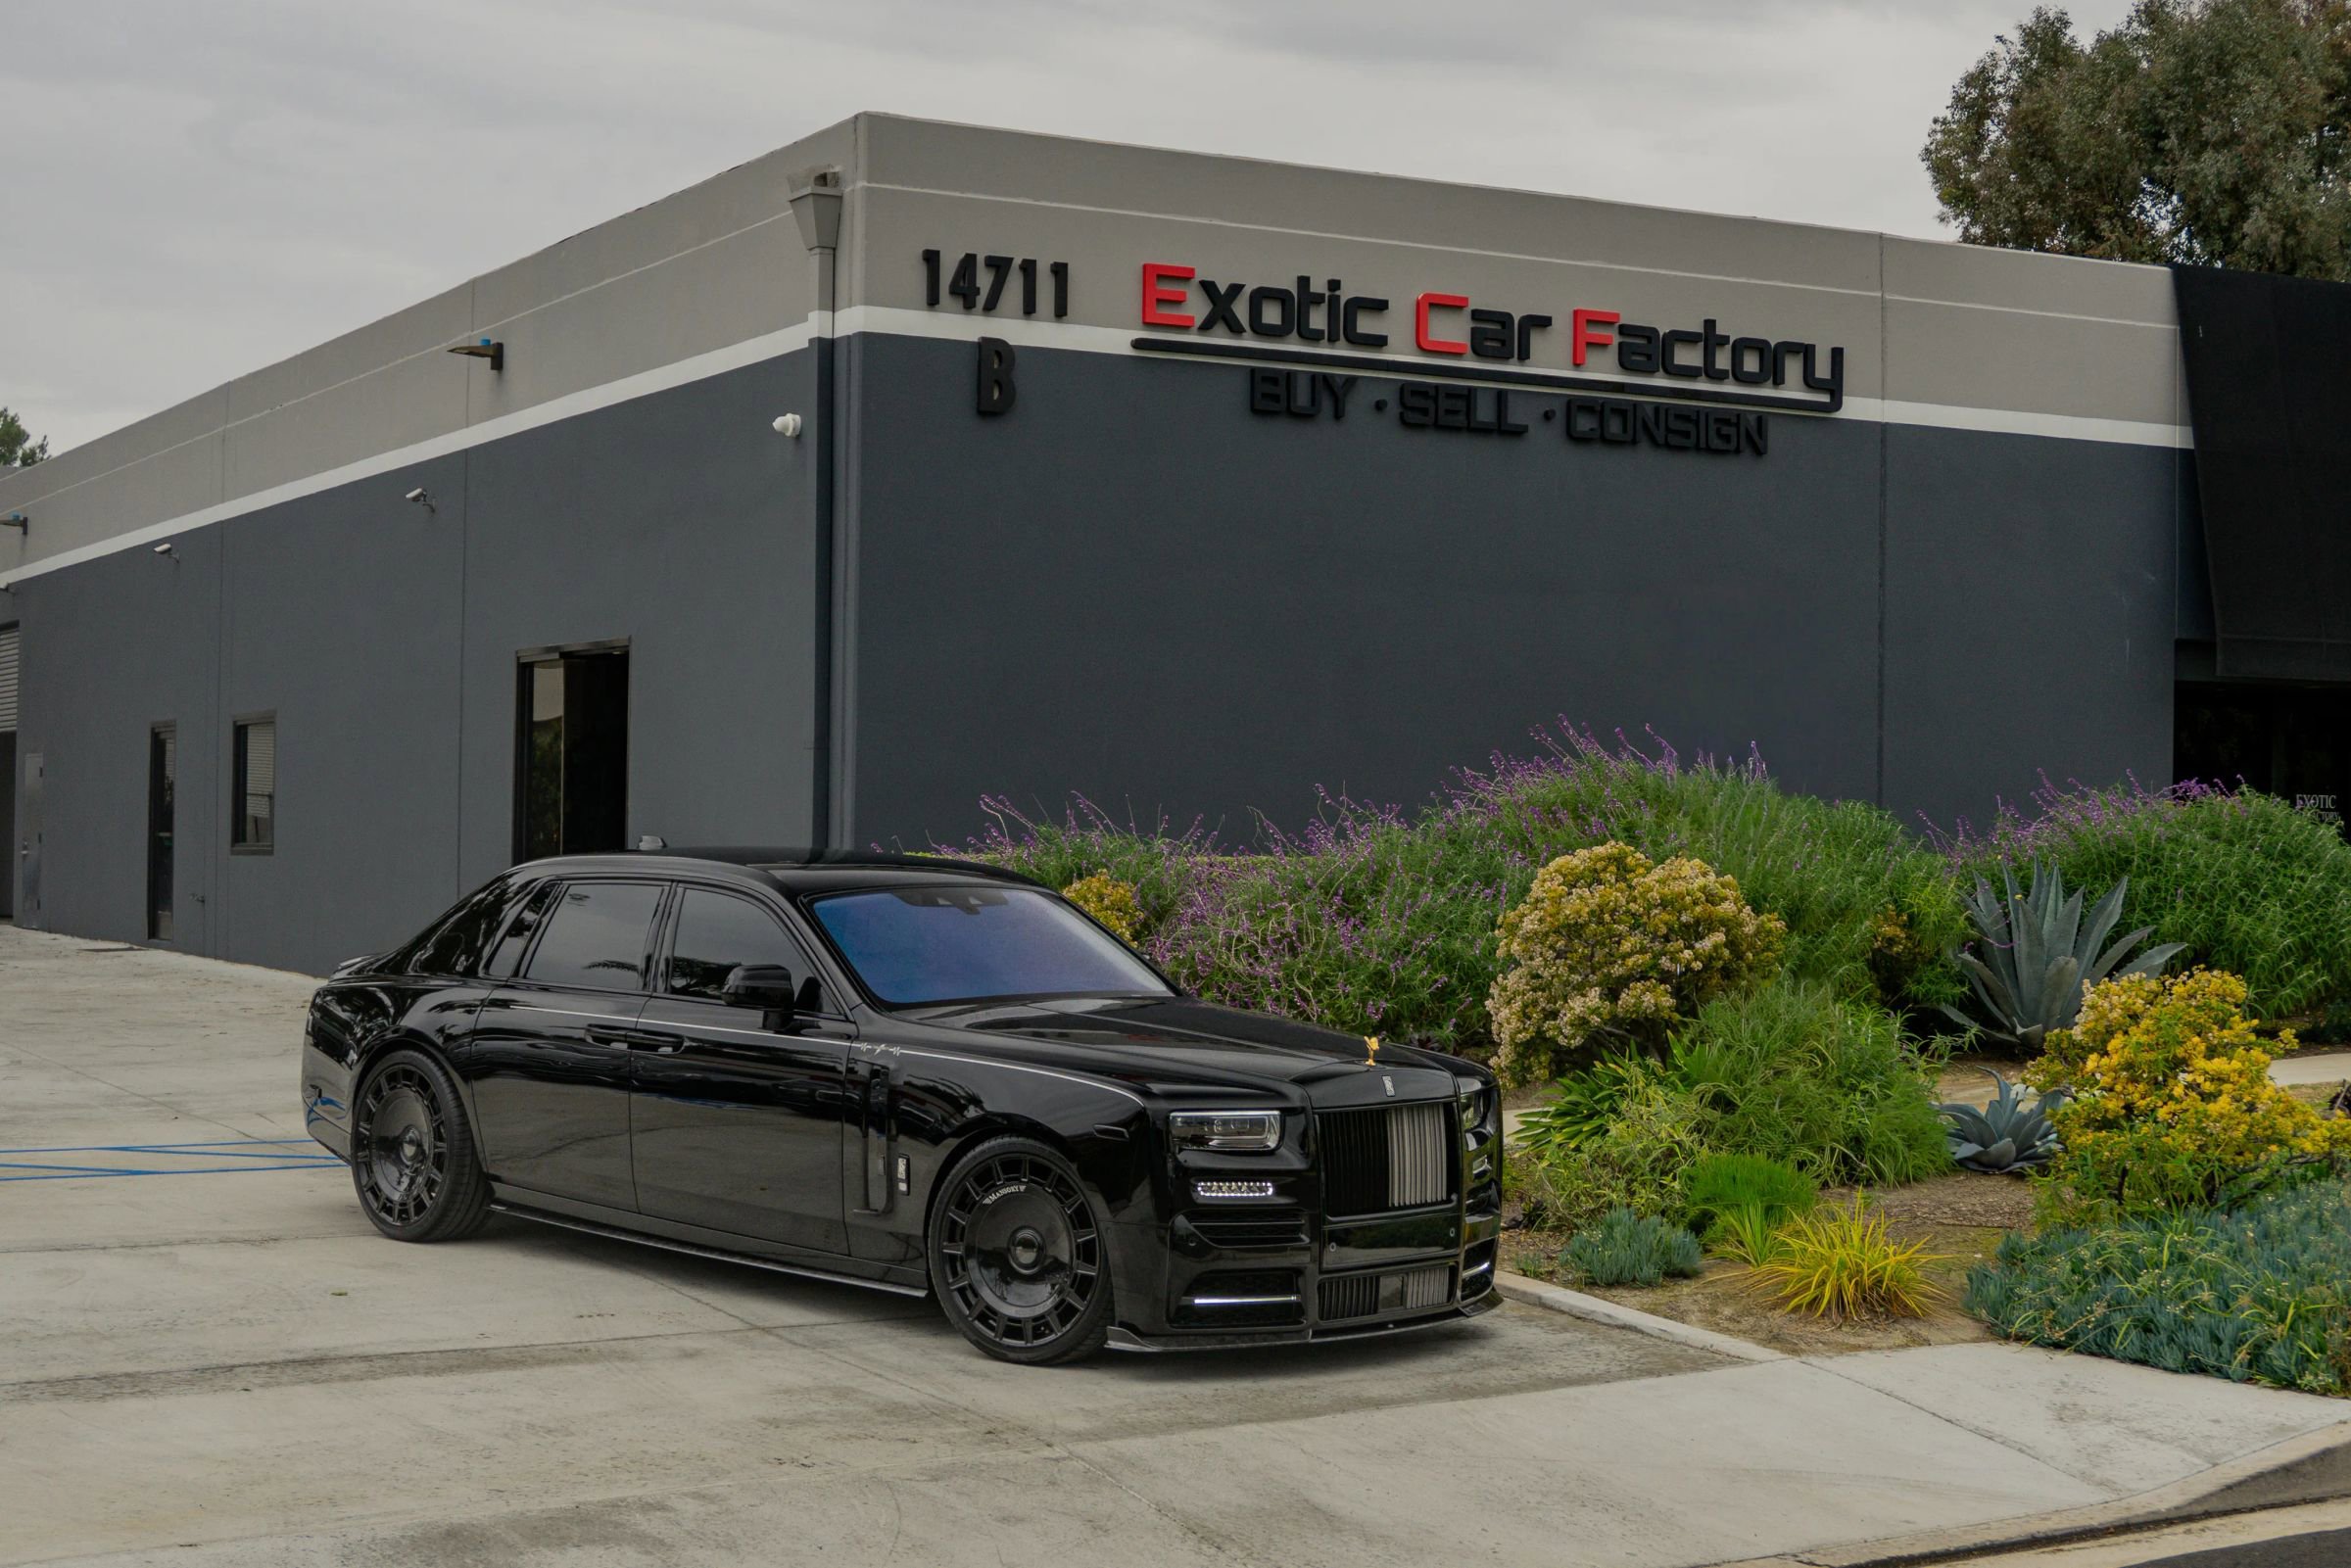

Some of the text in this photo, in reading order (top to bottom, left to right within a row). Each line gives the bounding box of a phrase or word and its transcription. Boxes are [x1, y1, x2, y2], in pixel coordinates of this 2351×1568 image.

[922, 249, 1069, 317] 14711
[977, 336, 1017, 415] B
[1141, 262, 1844, 412] Exotic Car Factory
[1250, 366, 1768, 455] BUY SELL CONSIGN
[2295, 793, 2336, 809] EXOTIC
